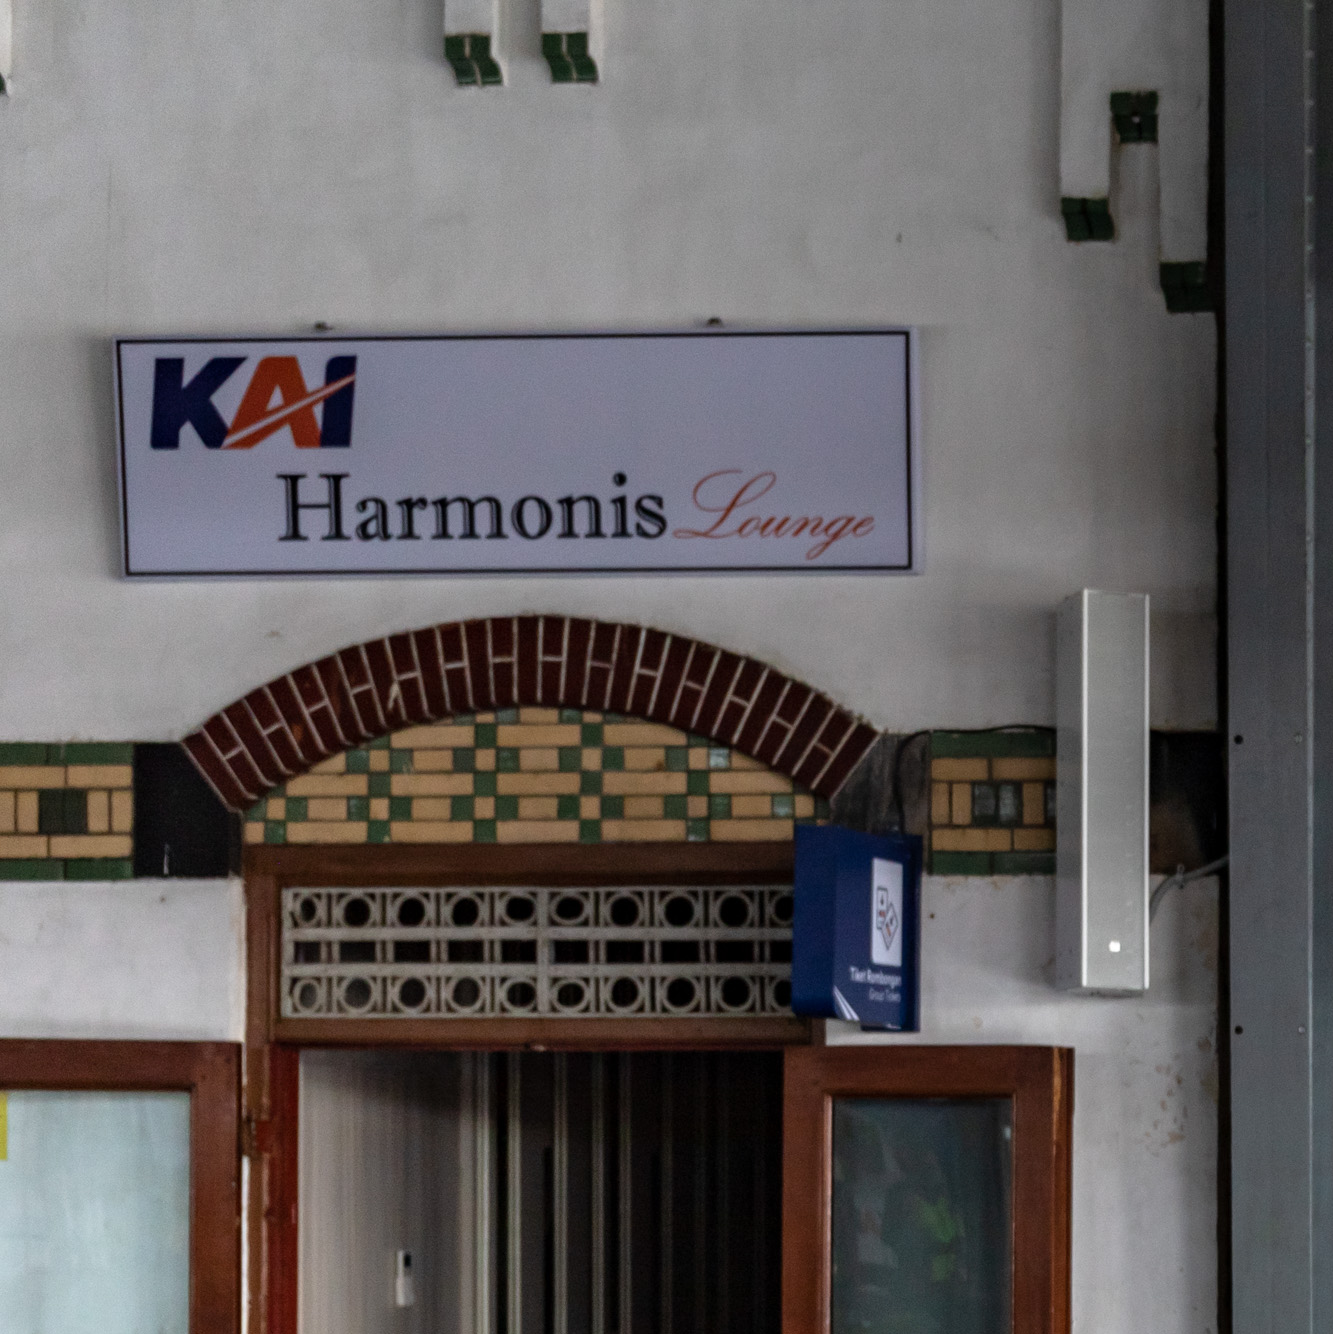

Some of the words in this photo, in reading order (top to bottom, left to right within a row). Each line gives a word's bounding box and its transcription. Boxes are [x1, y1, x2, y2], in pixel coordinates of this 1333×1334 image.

[150, 355, 358, 450] KAI
[276, 472, 669, 543] Harmonis
[672, 468, 876, 560] Lounge
